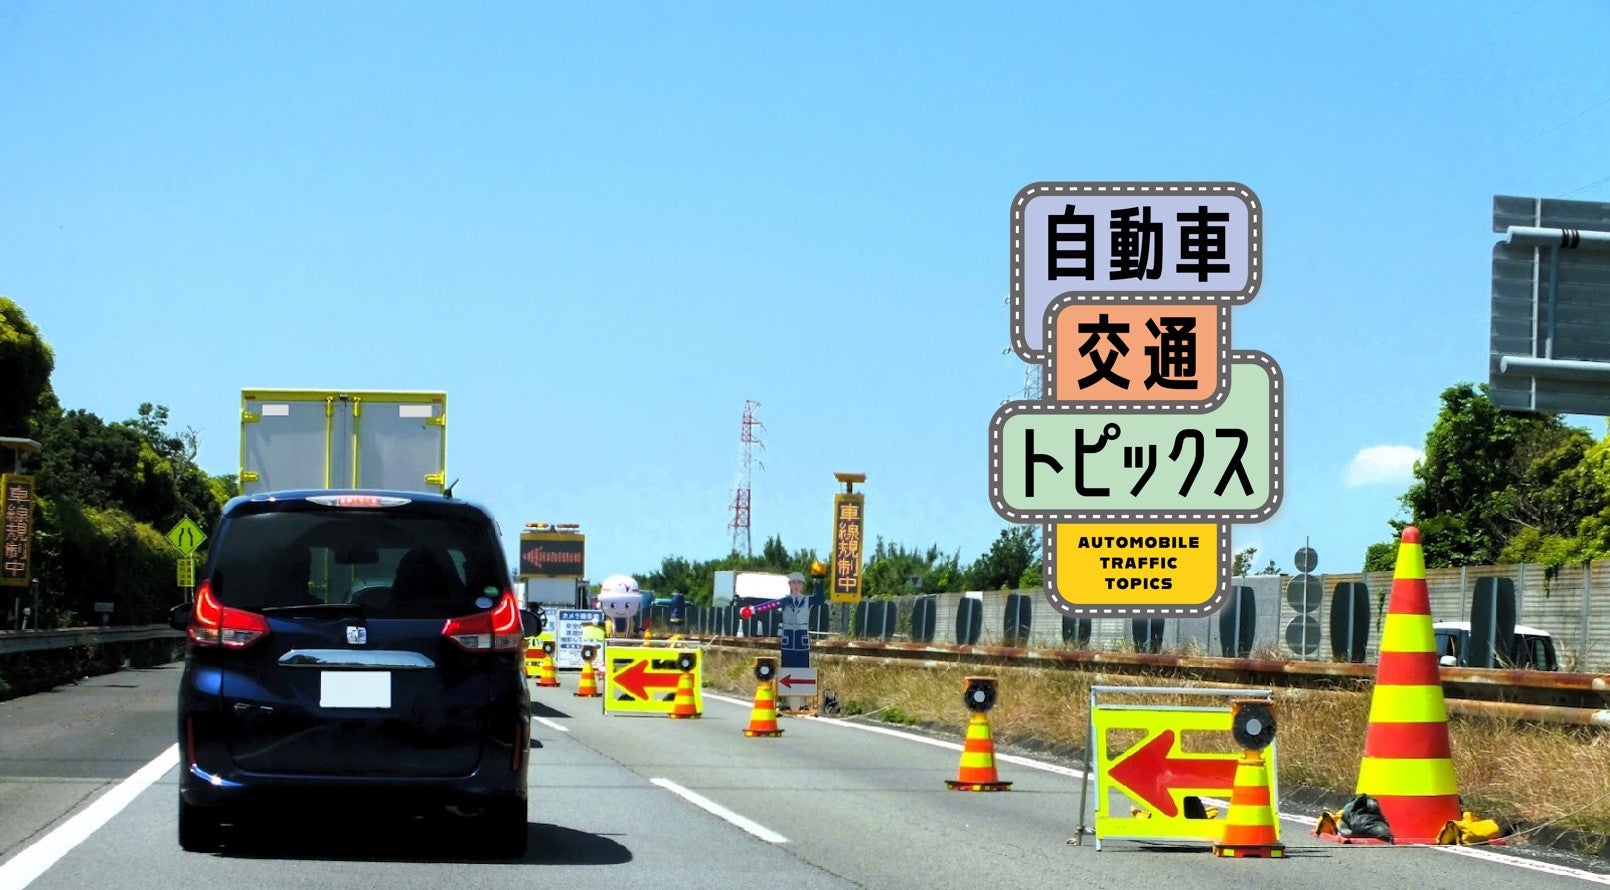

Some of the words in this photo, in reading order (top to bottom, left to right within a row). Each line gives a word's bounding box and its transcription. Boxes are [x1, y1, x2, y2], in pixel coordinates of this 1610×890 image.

[6, 486, 30, 576] 車線規制中
[838, 503, 860, 592] 車線規制中
